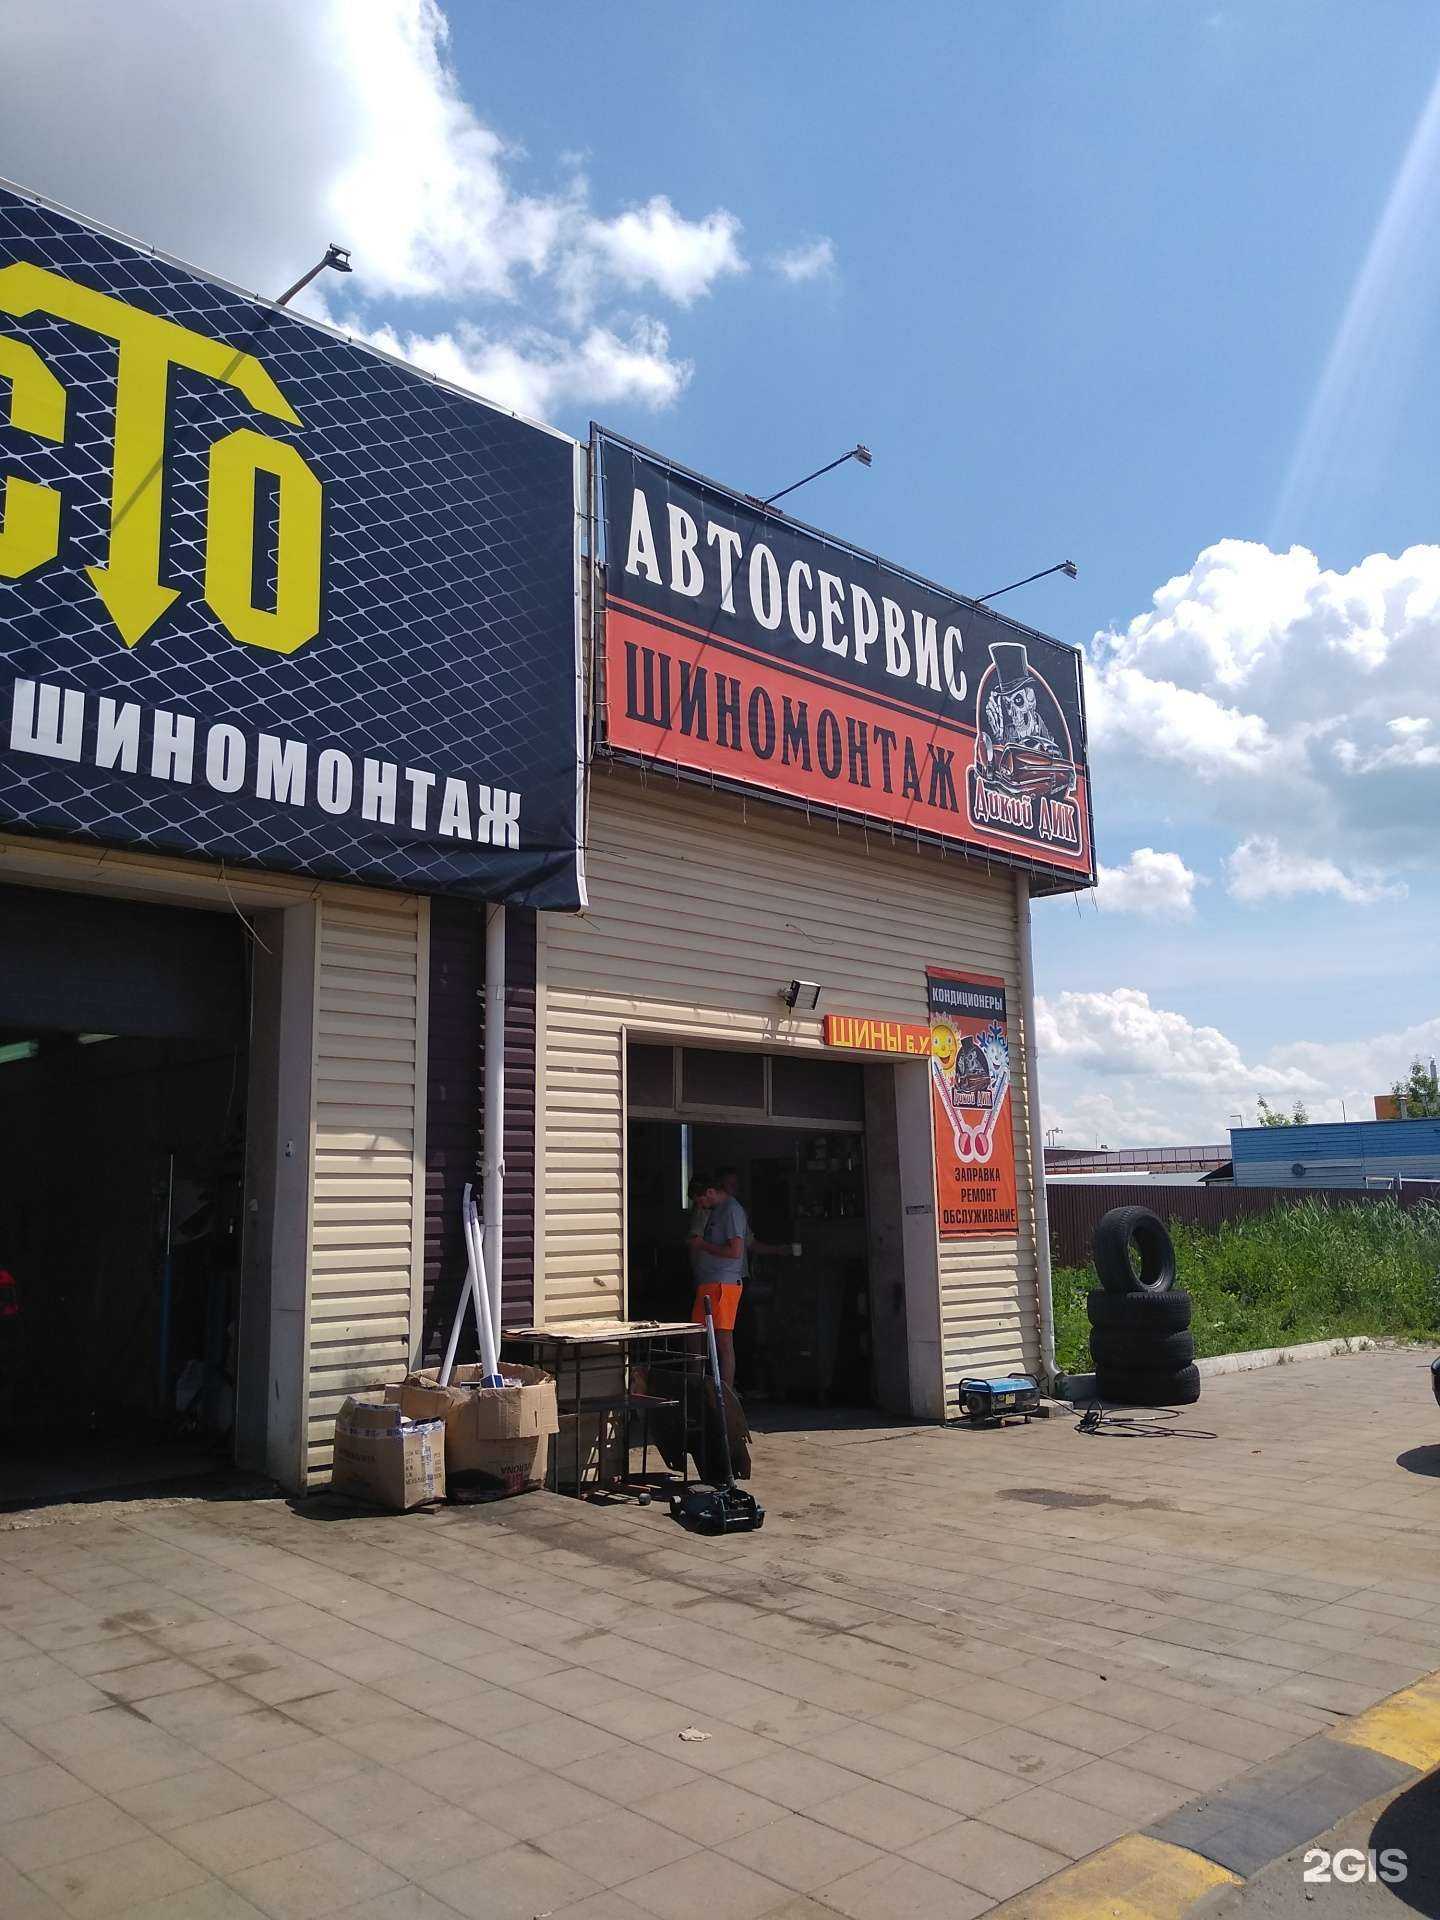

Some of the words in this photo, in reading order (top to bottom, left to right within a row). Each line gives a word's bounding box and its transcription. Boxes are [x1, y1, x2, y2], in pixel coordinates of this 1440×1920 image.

[624, 488, 967, 701] АВТОСЕРВИС
[623, 640, 960, 813] ШИНОМОНТАЖ
[9, 677, 522, 850] ШИНОМОНТАЖ
[932, 987, 1003, 1010] КОНДИЦИОНЕРЫ
[832, 1016, 902, 1052] ШИНЫ
[954, 1167, 1001, 1182] ЗАПРАВКА
[960, 1188, 997, 1203] РЕМОНТ
[943, 1208, 1016, 1225] ОБСЛУЖИВАНИЕ
